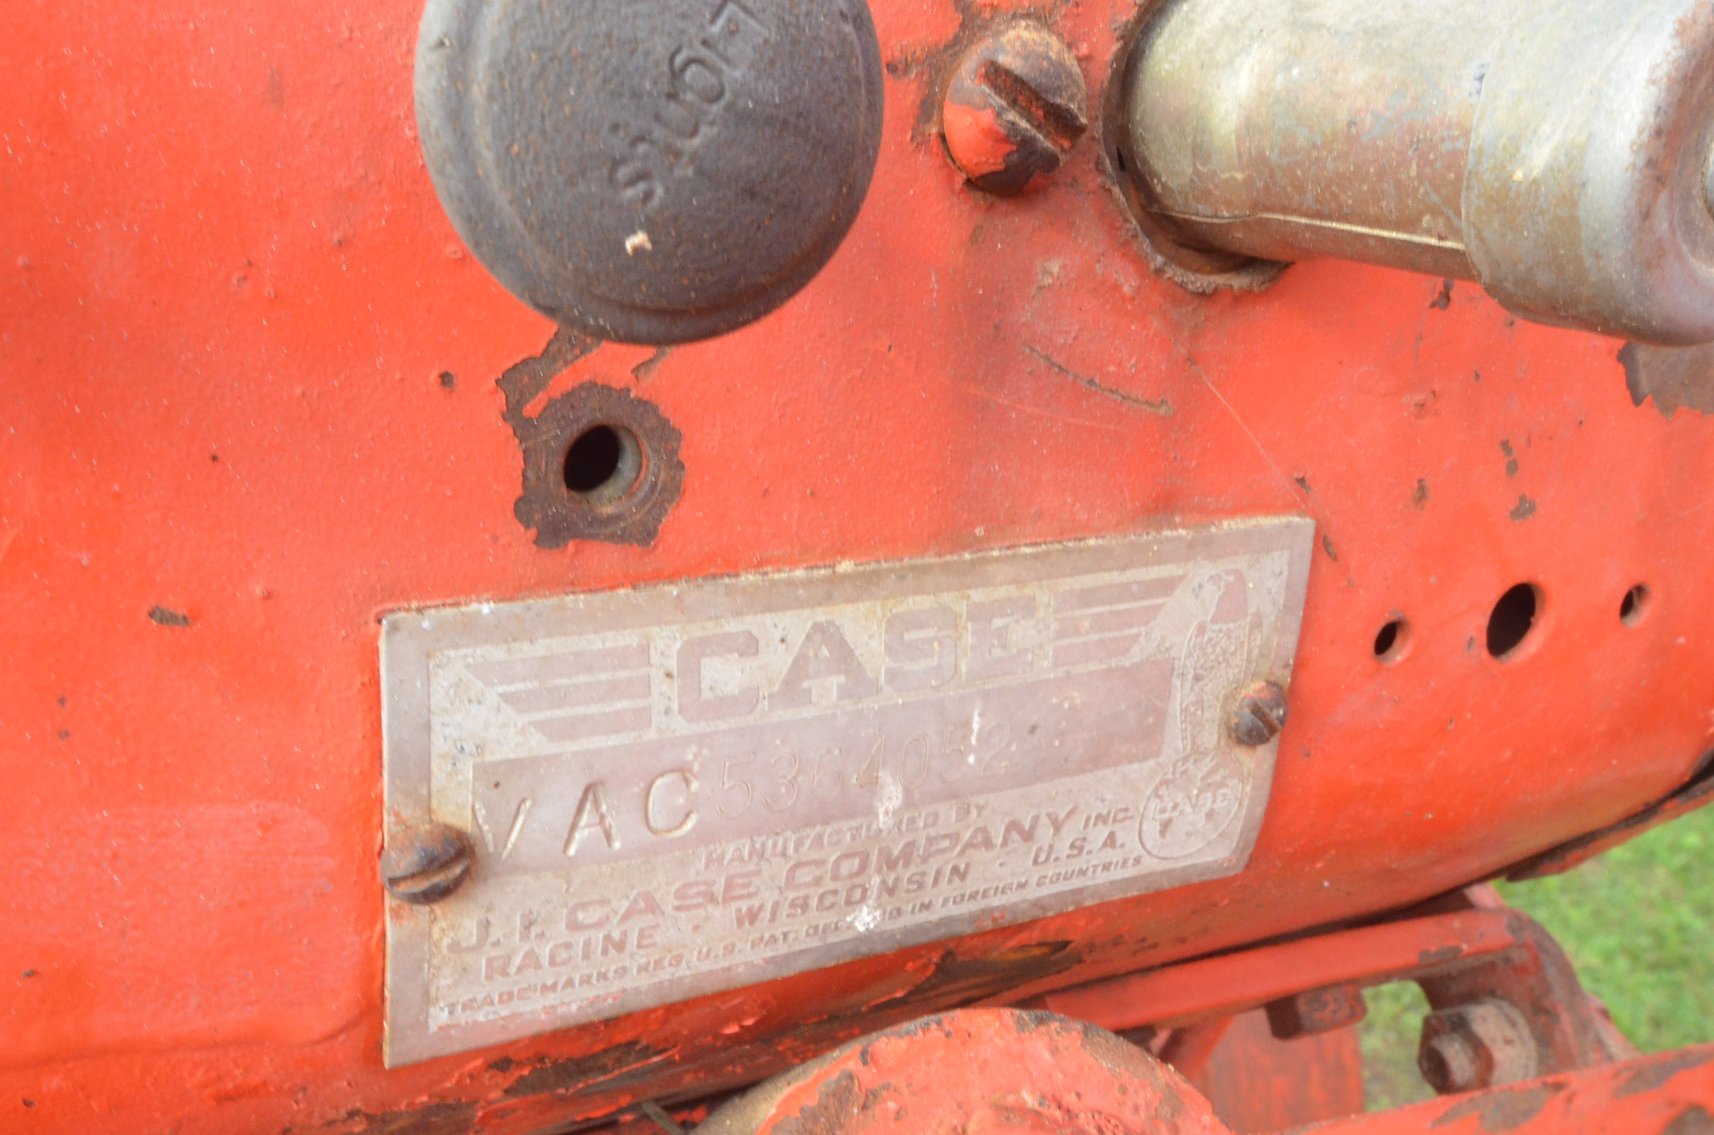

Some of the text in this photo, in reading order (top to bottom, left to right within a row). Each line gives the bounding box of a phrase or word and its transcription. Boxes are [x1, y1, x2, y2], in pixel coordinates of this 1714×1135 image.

[673, 594, 1040, 725] CASE
[564, 868, 762, 934] CASE
[782, 804, 1078, 893] COMPANY
[953, 799, 988, 823] BY
[482, 826, 1129, 983] RACINE WISCONSIN U.S.A.
[910, 898, 933, 915] IN
[939, 878, 1029, 909] FOREIGN
[1034, 853, 1143, 888] COUNTRIES
